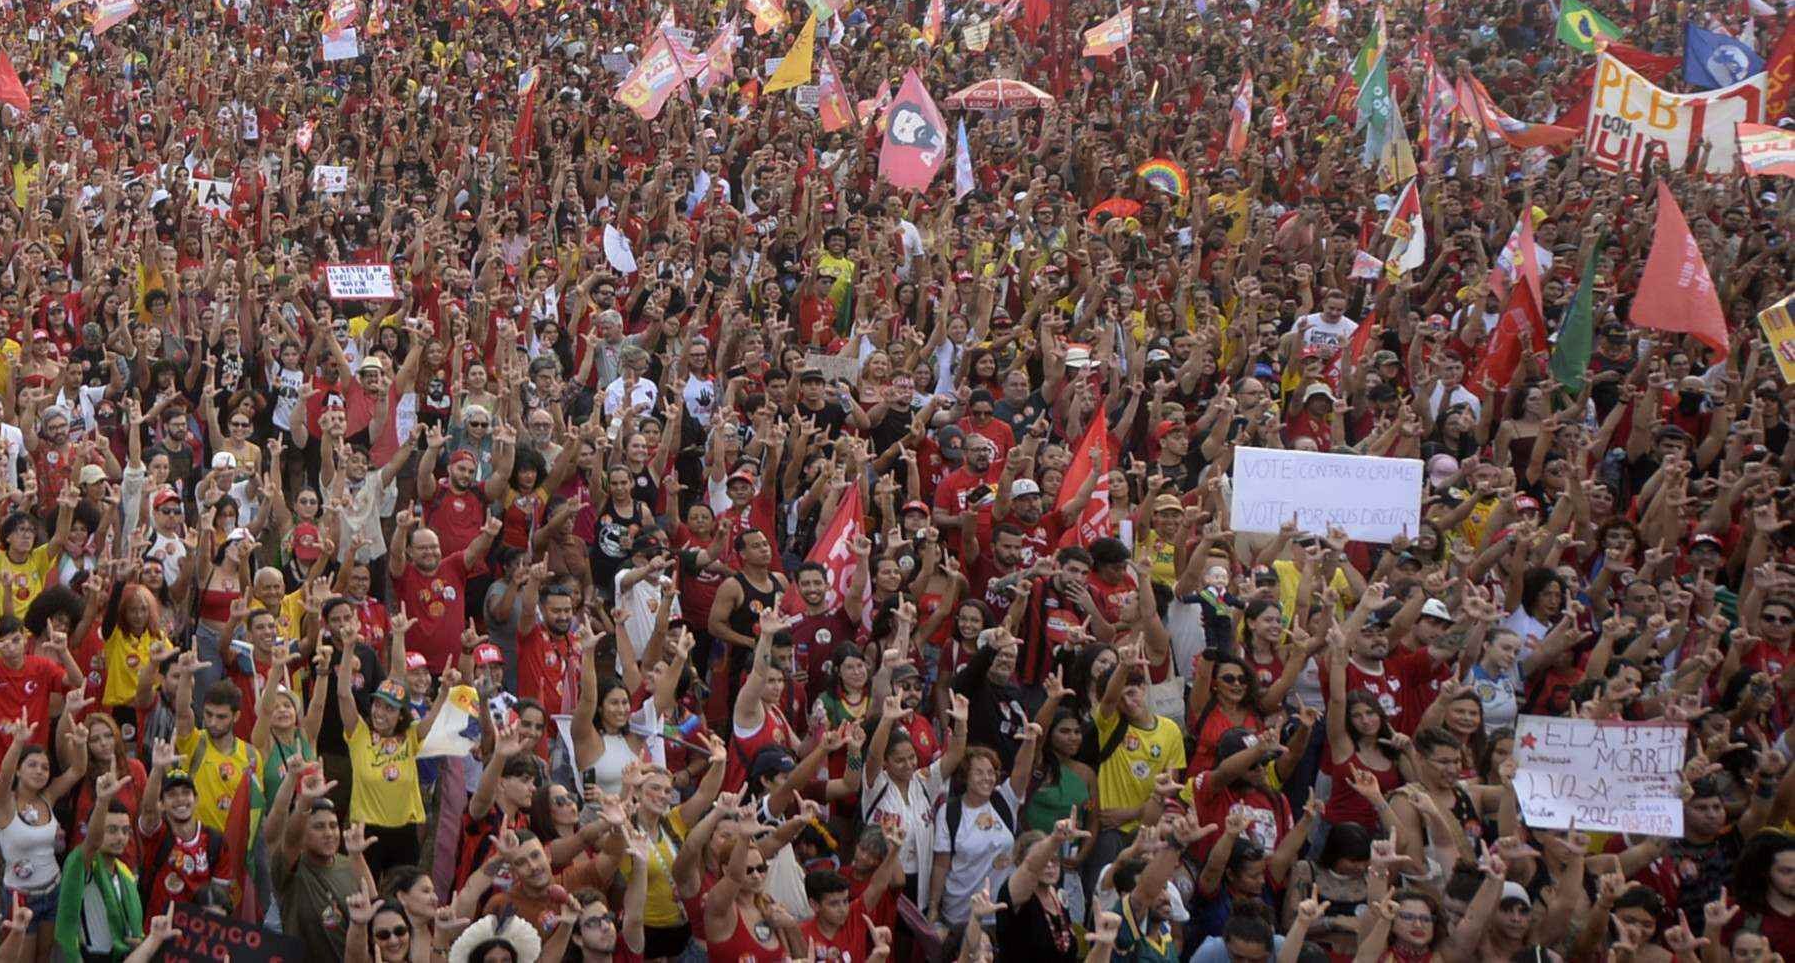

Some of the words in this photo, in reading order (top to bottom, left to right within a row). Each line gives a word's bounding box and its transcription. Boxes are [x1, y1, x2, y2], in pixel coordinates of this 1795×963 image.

[1596, 59, 1680, 130] PCB
[1602, 113, 1632, 137] COM
[1243, 458, 1293, 480] VOTE
[1298, 461, 1351, 480] CONTRA
[1368, 465, 1415, 481] CRIME
[1240, 499, 1291, 525] VOTE
[1297, 506, 1324, 525] POR
[1328, 507, 1358, 525] SEUS
[1360, 507, 1417, 525] DIREITOS
[1545, 721, 1608, 748] ELA
